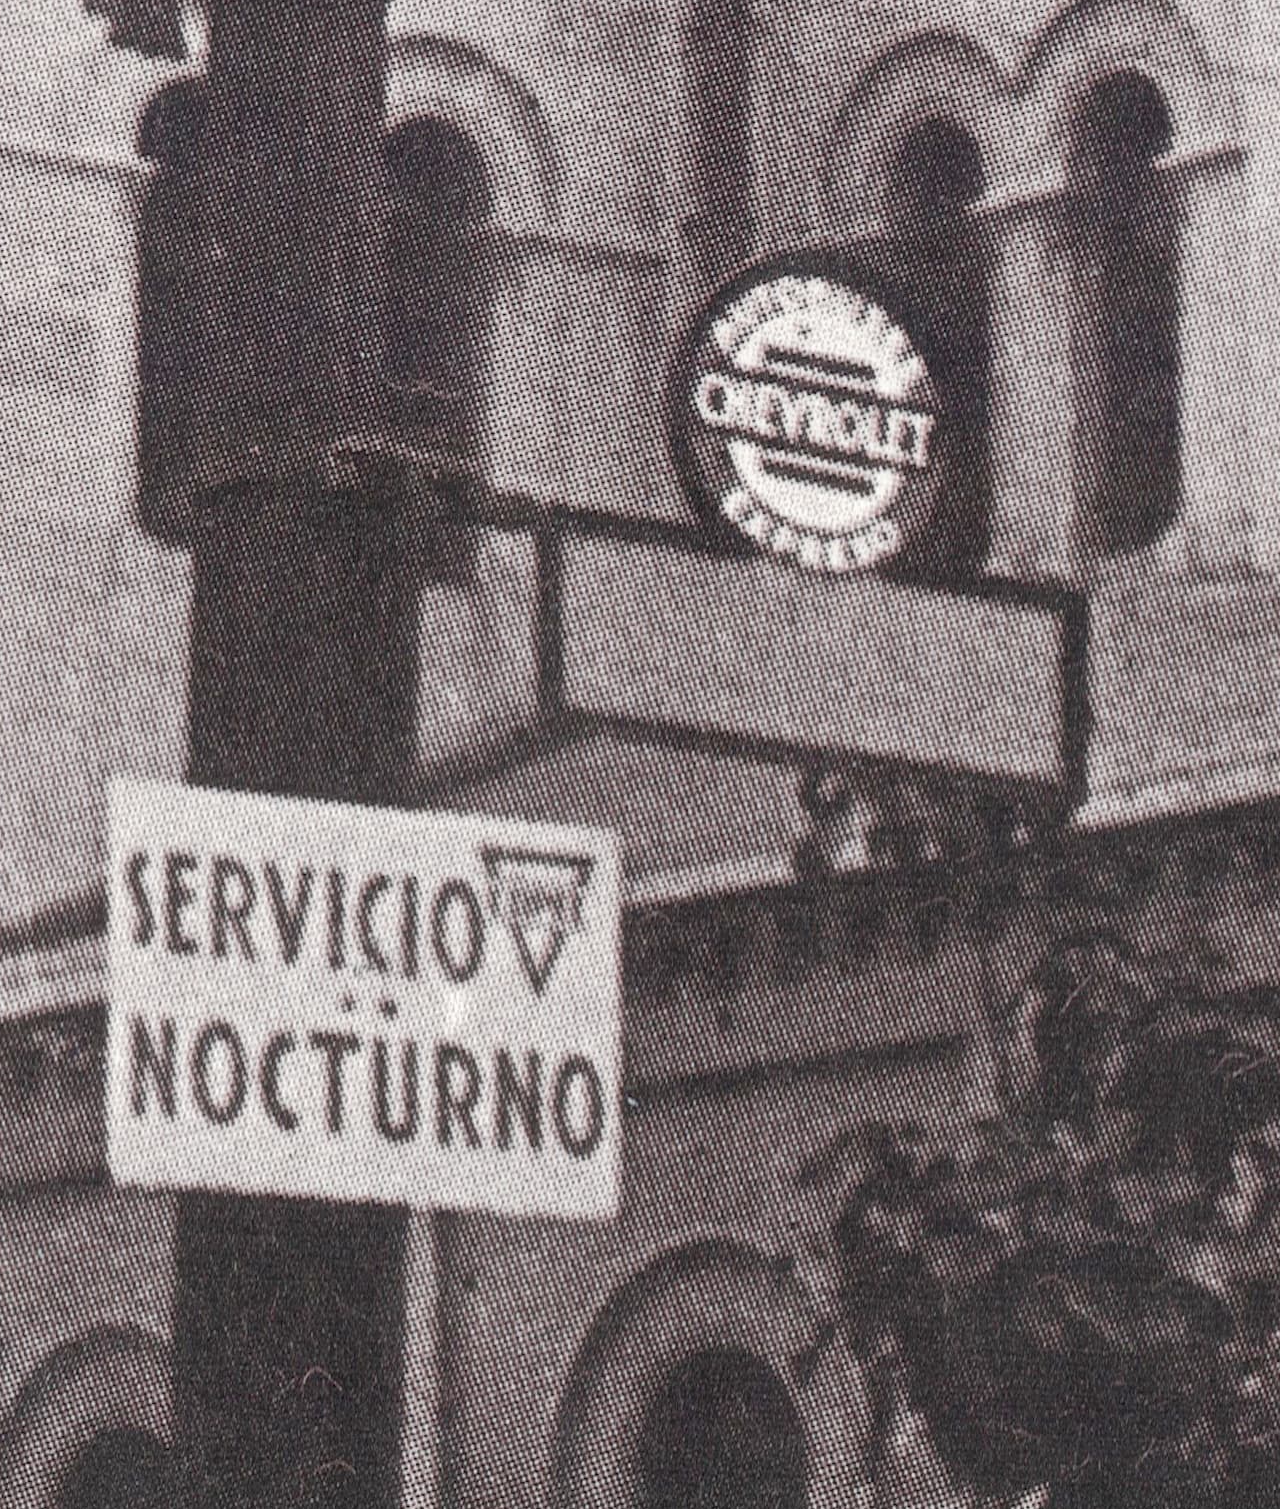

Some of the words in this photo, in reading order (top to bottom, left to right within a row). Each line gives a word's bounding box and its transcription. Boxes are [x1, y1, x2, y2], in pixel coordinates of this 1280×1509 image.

[693, 372, 936, 469] CHEVROLET
[124, 848, 486, 984] SERVICIO
[128, 1015, 603, 1161] NOCTURNO
